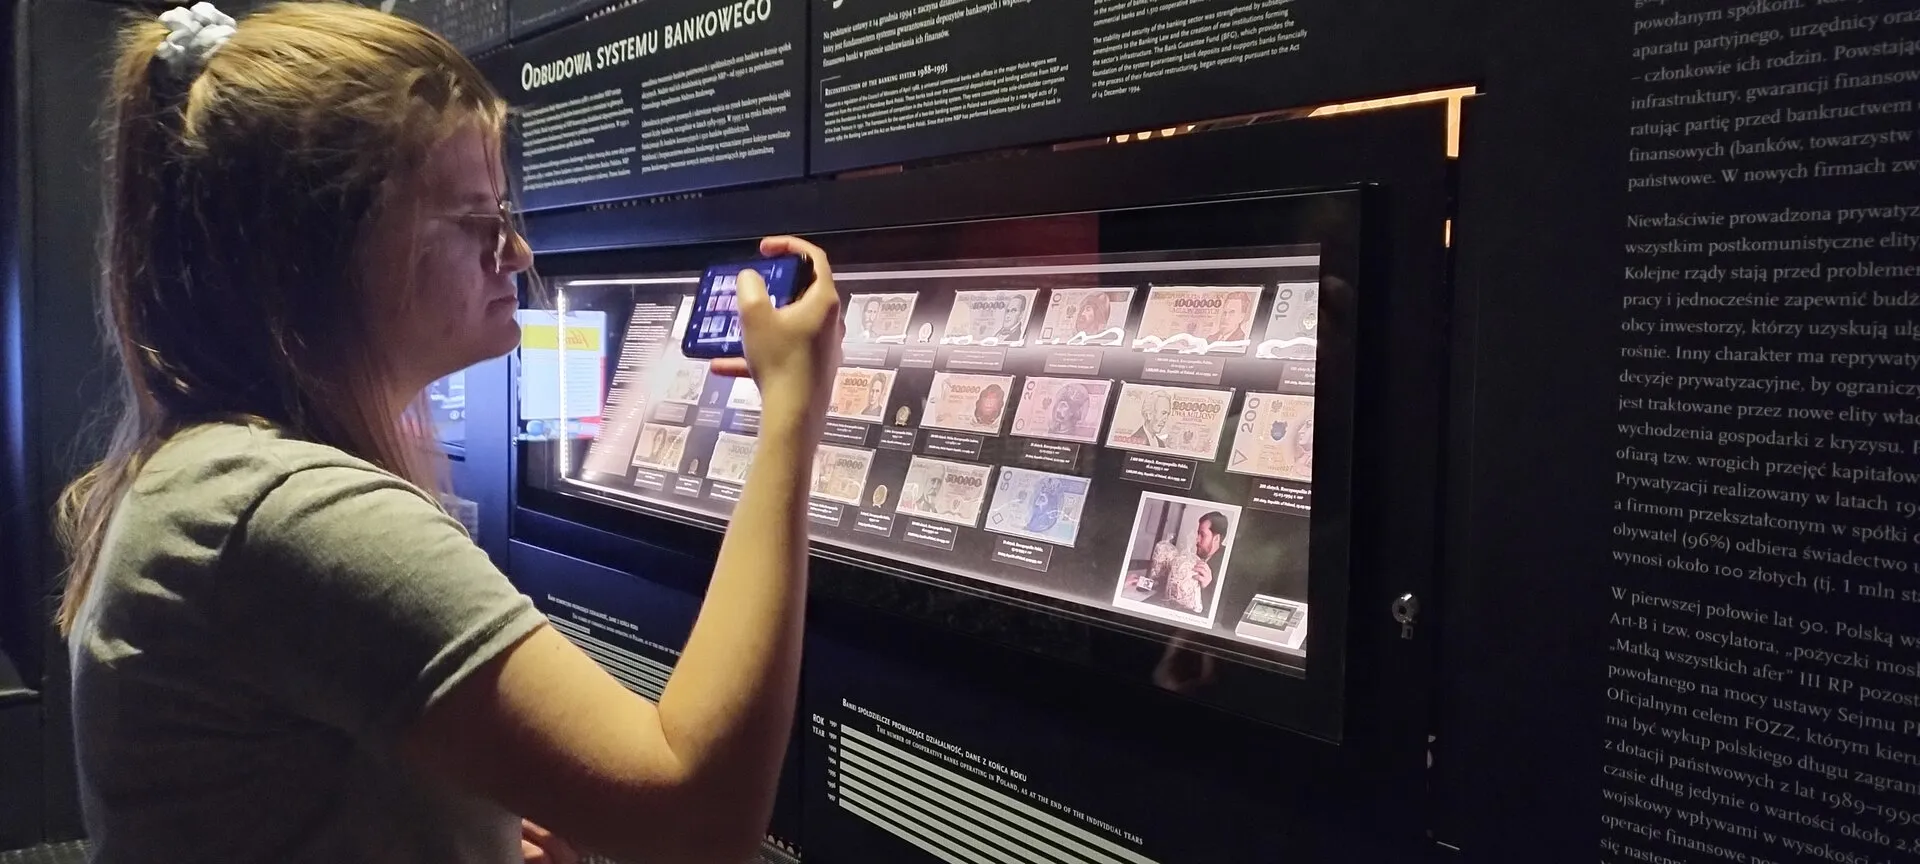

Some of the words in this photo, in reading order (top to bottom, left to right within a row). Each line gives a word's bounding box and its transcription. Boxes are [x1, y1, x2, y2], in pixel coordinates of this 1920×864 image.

[896, 16, 935, 36] gwarantowania
[965, 0, 997, 16] bankowych
[521, 51, 592, 91] ODBUDOWA
[596, 29, 658, 70] SYSTEMU
[664, 0, 772, 49] BANKOWEGO
[914, 33, 923, 44] ich
[923, 28, 949, 42] finansów.
[1091, 58, 1100, 66] the
[1100, 55, 1119, 64] sector's
[1119, 48, 1152, 60] infrastructure.
[1153, 45, 1163, 53] The
[1163, 42, 1177, 52] Bank
[1177, 38, 1205, 49] Guarantee
[1205, 33, 1220, 43] Fund
[1239, 26, 1257, 36] which
[1257, 21, 1283, 34] provides
[1283, 19, 1294, 28] the
[1631, 40, 1688, 60] aparatu
[1693, 28, 1784, 54] partyjnego,
[1789, 14, 1878, 37] urzędnicy
[1097, 79, 1105, 87] the
[1105, 76, 1124, 87] process
[1124, 73, 1130, 82] of
[1130, 73, 1142, 81] their
[1142, 67, 1163, 78] financial
[1163, 63, 1198, 74] restructuring,
[1199, 59, 1216, 69] began
[1216, 54, 1243, 66] operating
[1243, 48, 1270, 62] pursuant
[1278, 45, 1288, 53] the
[1288, 43, 1300, 51] Act
[1091, 90, 1097, 98] of
[1103, 86, 1127, 96] December
[1626, 211, 1725, 227] Niewłaściwie
[1728, 206, 1831, 228] prowadzona
[1624, 264, 1680, 283] Kolejne
[1683, 263, 1726, 283] rządy
[1730, 264, 1767, 282] stają
[1772, 261, 1821, 282] przed
[1052, 293, 1062, 308] 10
[1275, 288, 1293, 321] 100
[1620, 316, 1656, 335] obcy
[1659, 318, 1745, 337] inwestorzy,
[1750, 318, 1803, 338] którzy
[1808, 319, 1887, 339] uzyskują
[1024, 380, 1036, 400] 20
[1241, 397, 1261, 434] 200
[1618, 394, 1643, 411] jest
[1647, 396, 1732, 414] traktowane
[1736, 404, 1782, 419] przez
[1787, 407, 1834, 420] nowe
[1838, 405, 1877, 426] elity
[1615, 445, 1658, 466] ofiarą
[1663, 451, 1691, 465] tzw.
[1696, 455, 1759, 473] wrogich
[1765, 460, 1826, 479] przejęć
[1000, 470, 1013, 492] 50
[1616, 470, 1707, 496] Prywatyzacji
[1712, 481, 1810, 507] realizowany
[1814, 493, 1829, 504] w
[1835, 490, 1888, 511] latach
[1612, 521, 1676, 543] obywatel
[1681, 531, 1730, 553] (96%)
[1734, 537, 1797, 558] odbiera
[1802, 545, 1907, 571] świadectwo
[1611, 550, 1662, 567] wynosi
[1666, 554, 1709, 573] około
[1714, 564, 1743, 578] 100
[1747, 565, 1806, 588] złotych
[1812, 575, 1835, 593] (tj.
[1843, 578, 1849, 593] 1
[1858, 581, 1894, 599] mln
[1610, 585, 1626, 600] W
[1630, 590, 1700, 616] pierwszej
[1705, 602, 1768, 623] połowie
[1773, 610, 1793, 628] lat
[1799, 619, 1828, 634] 90.
[1835, 620, 1893, 648] Polską
[1609, 637, 1660, 662] „Matką
[1664, 649, 1747, 675] wszystkich
[812, 713, 825, 726] ROK
[812, 725, 826, 738] YEAR
[1606, 686, 1687, 716] Oficjalnym
[1691, 706, 1738, 727] celem
[1744, 715, 1800, 741] FOZZ,
[1806, 727, 1869, 755] którym
[964, 750, 980, 763] DANE
[982, 757, 986, 765] Z
[1009, 768, 1027, 782] ROKU
[1604, 738, 1612, 749] z
[1615, 738, 1663, 764] dotacji
[1668, 755, 1774, 789] państwowych
[1779, 781, 1789, 792] z
[1794, 779, 1814, 799] lat
[875, 723, 886, 735] THE
[995, 774, 1019, 793] POLAND,
[1020, 787, 1027, 795] AS
[1028, 791, 1036, 799] AT
[1037, 793, 1048, 804] THE
[1049, 799, 1062, 810] END
[1062, 805, 1071, 813] OF
[1072, 808, 1084, 820] THE
[1085, 814, 1122, 836] INDIVIDUAL
[1123, 830, 1143, 845] YEARS
